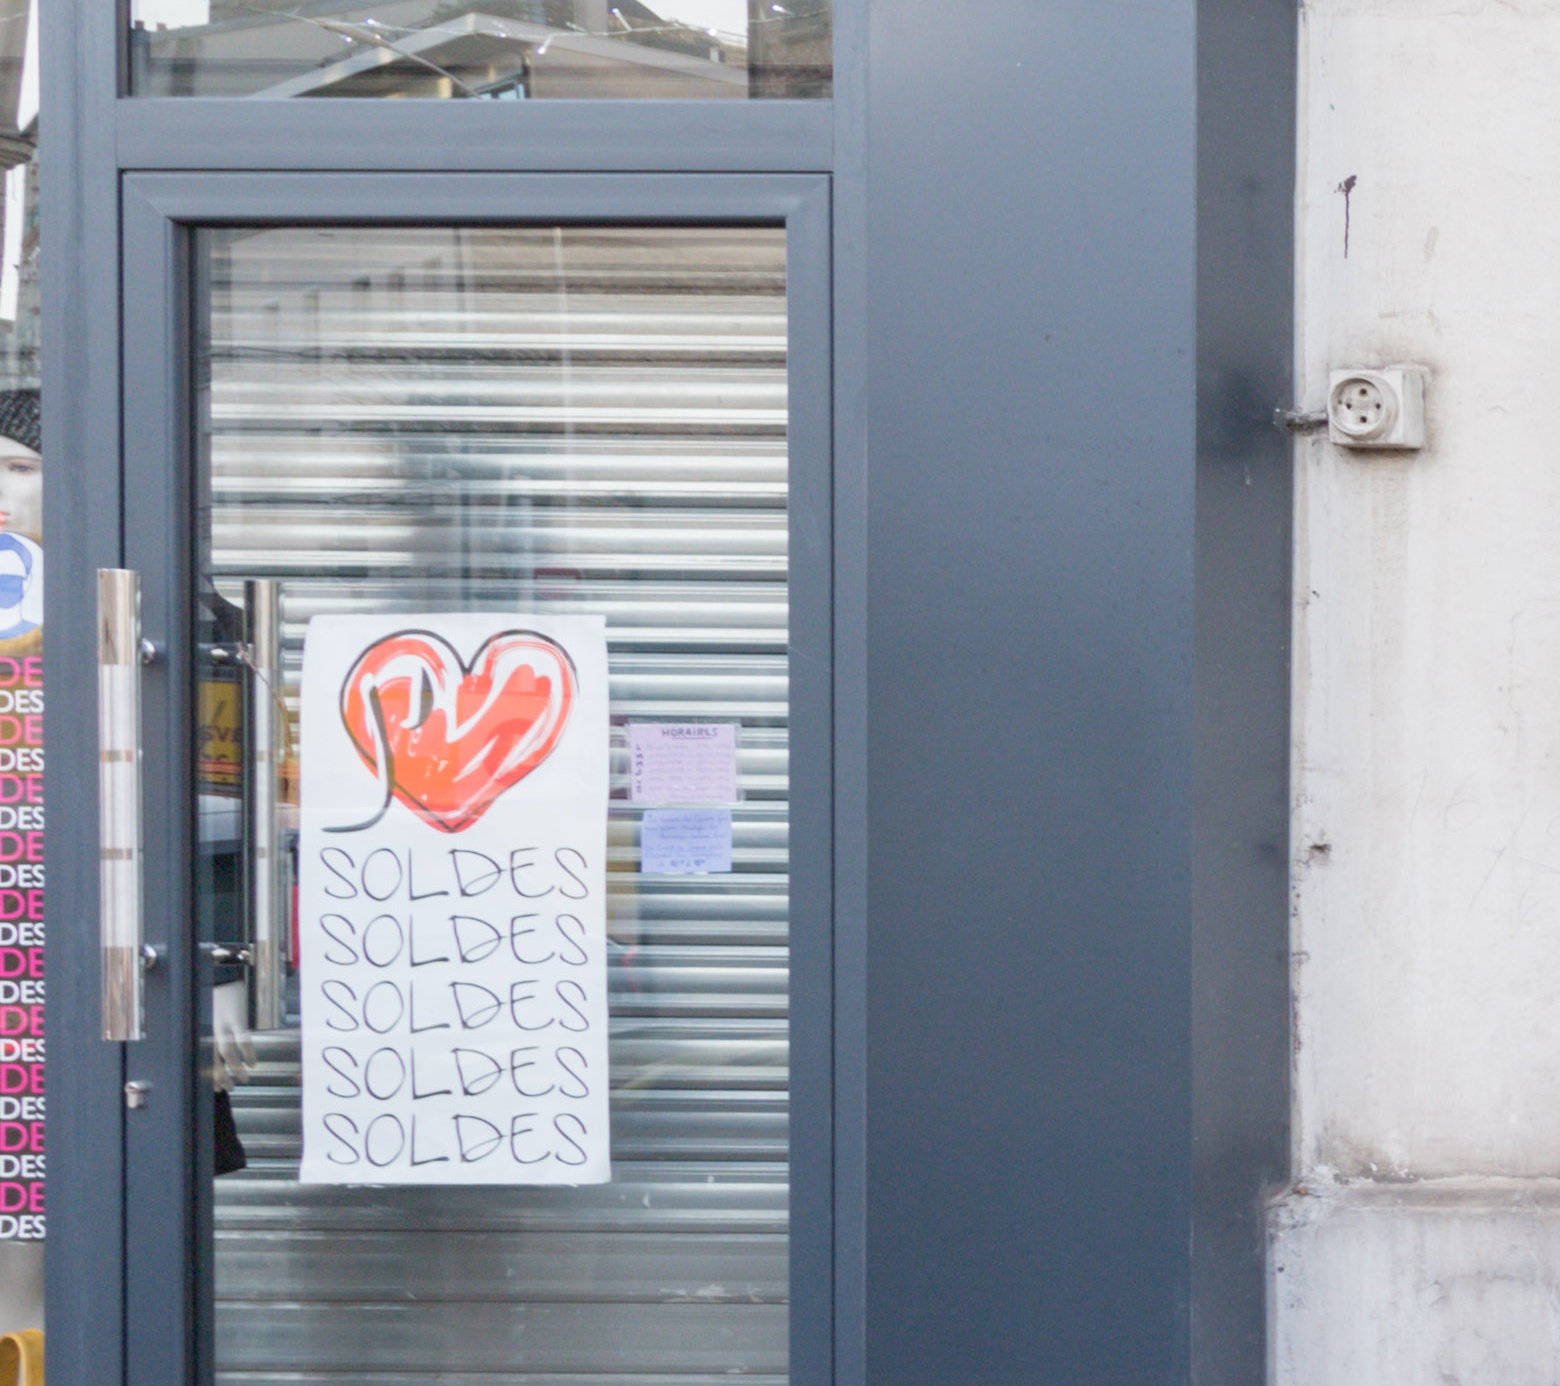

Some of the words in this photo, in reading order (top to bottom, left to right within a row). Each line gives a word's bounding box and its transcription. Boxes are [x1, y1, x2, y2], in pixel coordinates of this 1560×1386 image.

[320, 847, 588, 900] SOLDES
[320, 914, 588, 967] SOLDES
[320, 980, 588, 1033] SOLDES
[320, 1046, 588, 1099] SOLDES
[320, 1113, 588, 1166] SOLDES
